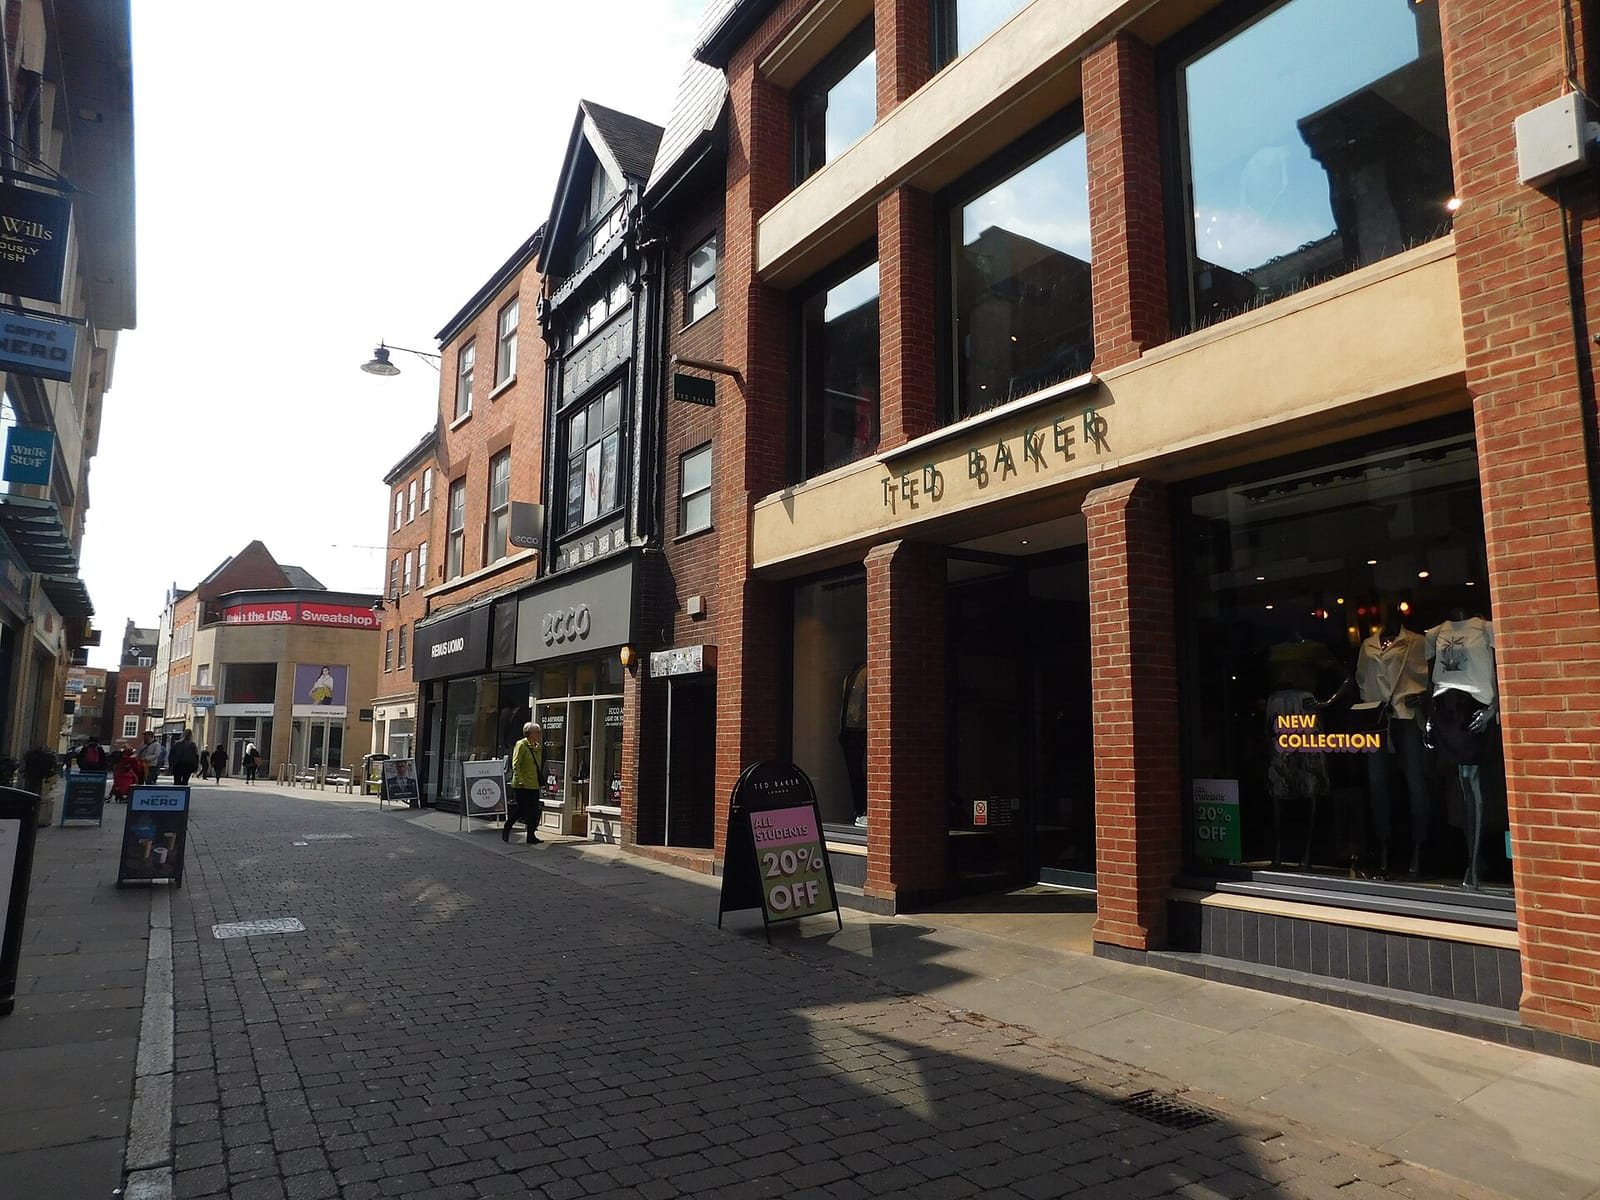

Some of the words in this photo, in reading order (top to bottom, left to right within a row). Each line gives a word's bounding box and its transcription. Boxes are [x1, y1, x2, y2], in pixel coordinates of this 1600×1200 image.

[2, 215, 53, 240] Wills
[0, 251, 26, 263] ISH
[880, 463, 938, 508] TED
[968, 406, 1100, 481] BAKER
[514, 535, 539, 545] ecco
[247, 611, 265, 622] the
[267, 609, 292, 621] USA.
[301, 609, 373, 627] Sweatshop
[542, 603, 591, 643] ecco
[431, 641, 448, 658] REMUS
[1277, 714, 1316, 729] NEW
[1278, 733, 1380, 749] COLLECTION
[753, 782, 769, 791] TED
[140, 798, 178, 807] NERO
[1198, 807, 1232, 822] 20%
[754, 816, 774, 830] ALL
[755, 825, 809, 842] STUDENTS
[1199, 825, 1227, 841] OFF
[762, 847, 824, 877] 20%
[769, 880, 819, 911] OFF
